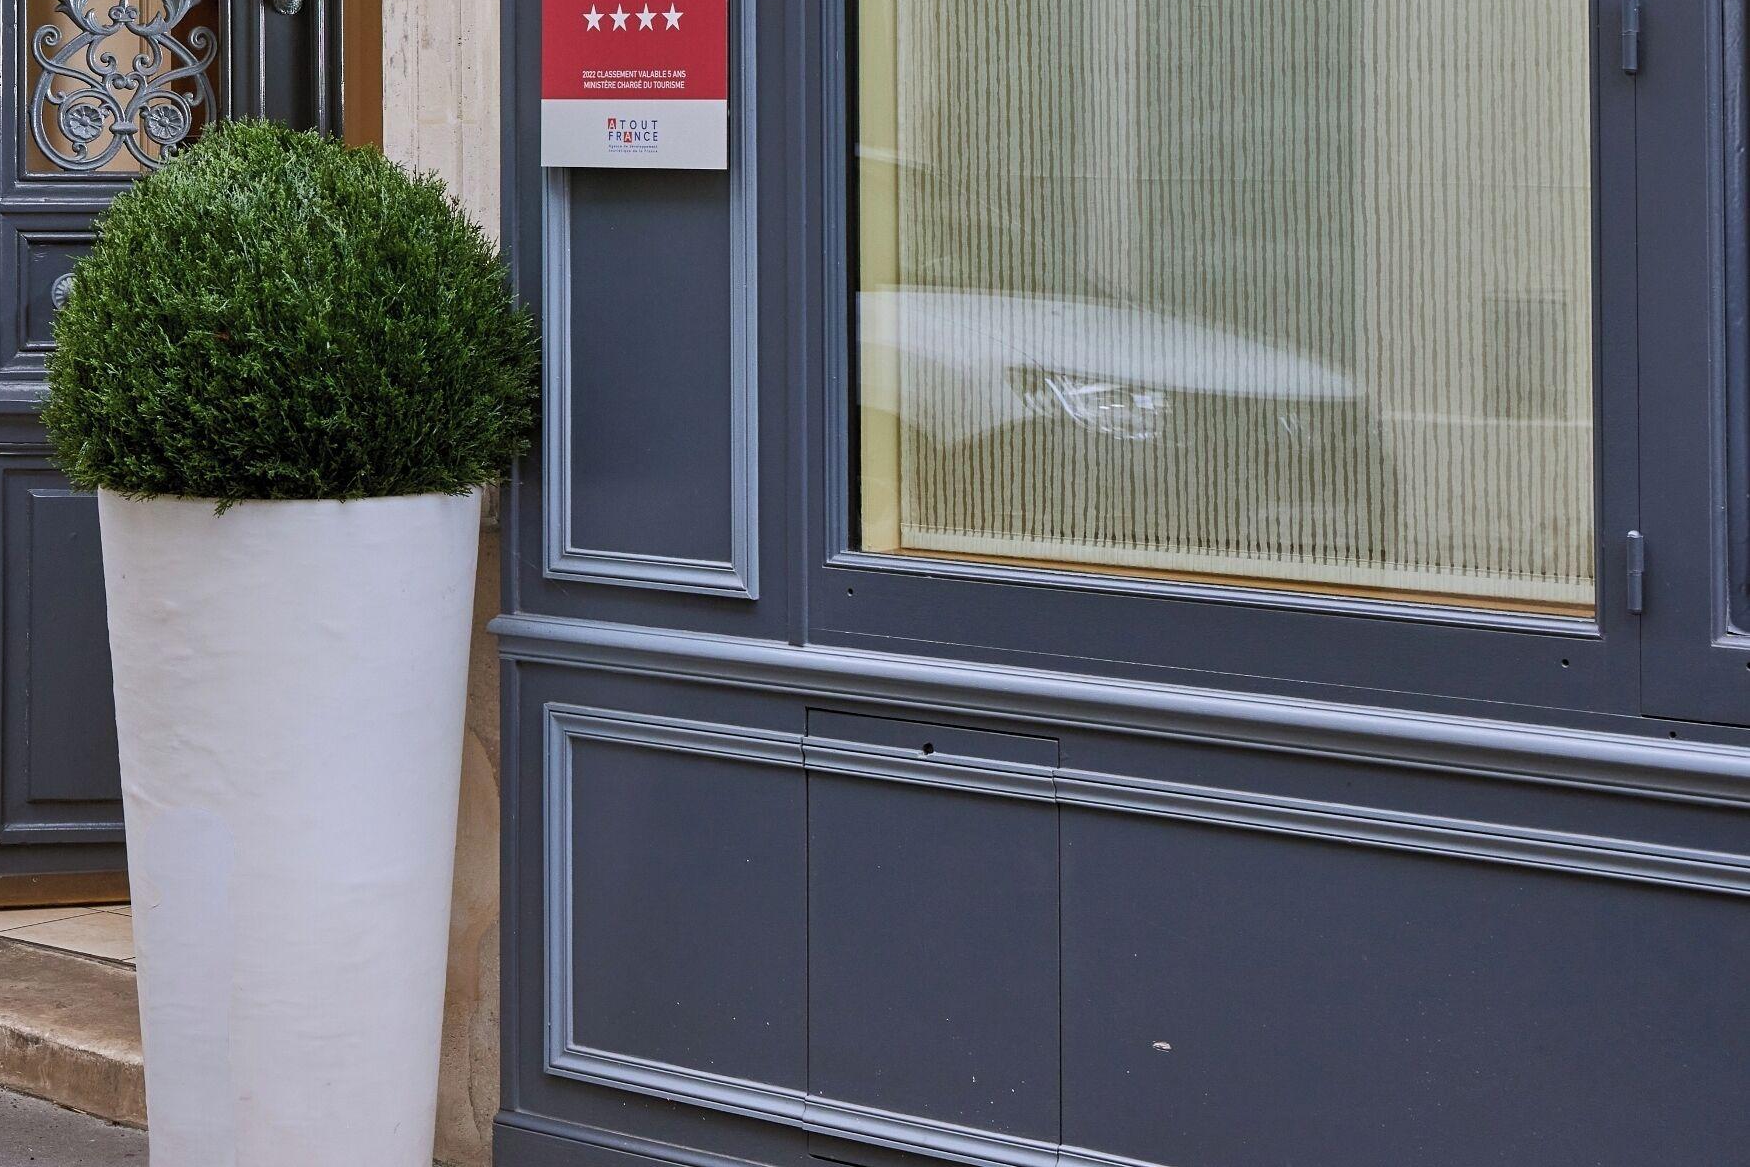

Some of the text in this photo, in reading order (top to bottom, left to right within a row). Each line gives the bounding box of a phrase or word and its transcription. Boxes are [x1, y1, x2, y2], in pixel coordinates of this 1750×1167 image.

[582, 70, 687, 79] 2022 CLASSEMENT VALABLE 5 ANS
[583, 80, 685, 89] MINISTÈRE CHARGÉ DU TOURISME
[608, 131, 658, 143] FRANCE
